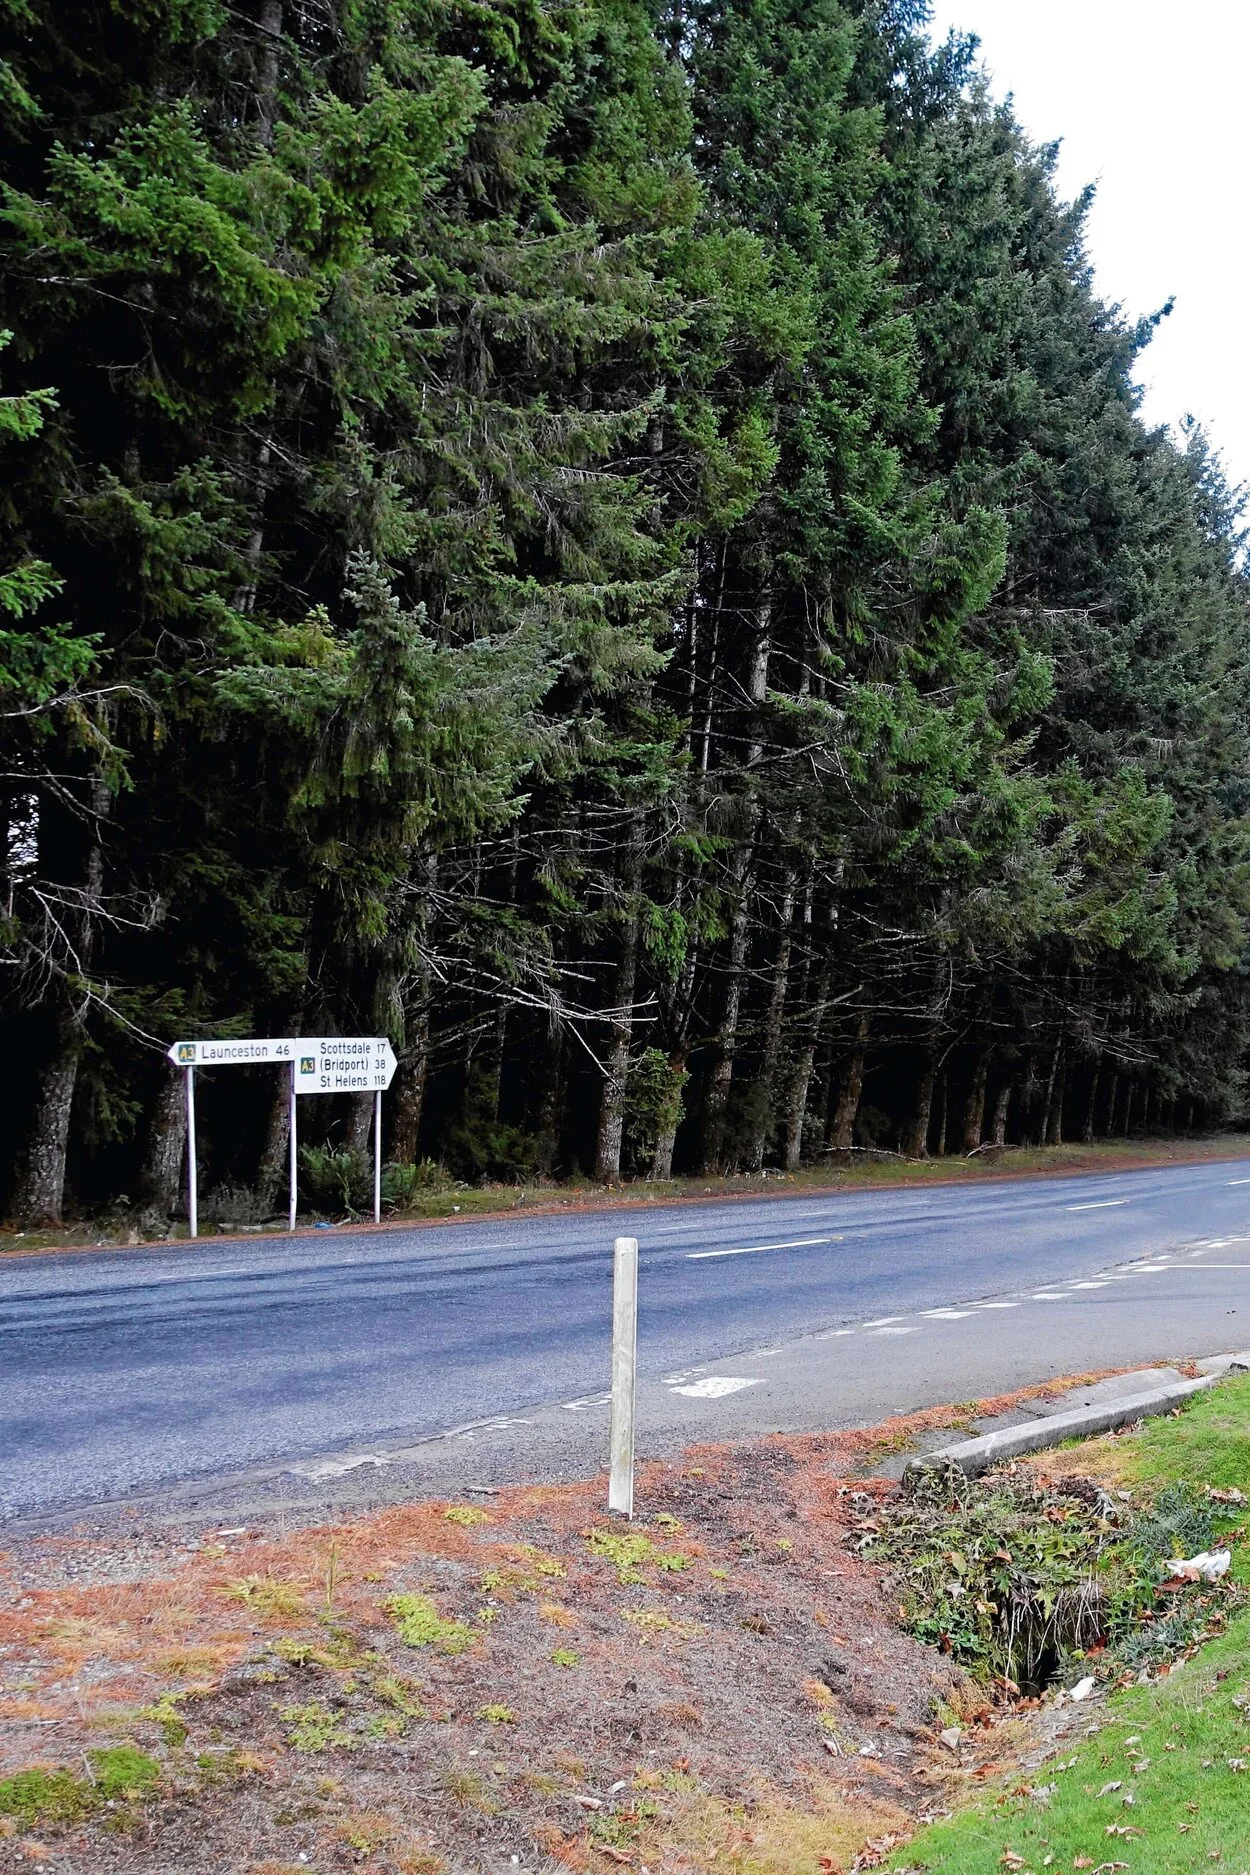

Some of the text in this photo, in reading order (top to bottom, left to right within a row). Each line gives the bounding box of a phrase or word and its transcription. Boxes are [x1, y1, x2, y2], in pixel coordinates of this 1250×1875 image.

[179, 1047, 195, 1060] A3
[202, 1044, 290, 1060] Launceston 46
[320, 1043, 386, 1055] Scottsdale 17
[301, 1060, 315, 1072] A3
[320, 1058, 386, 1073] (Bridport) 38
[320, 1075, 386, 1089] St Helens 118
